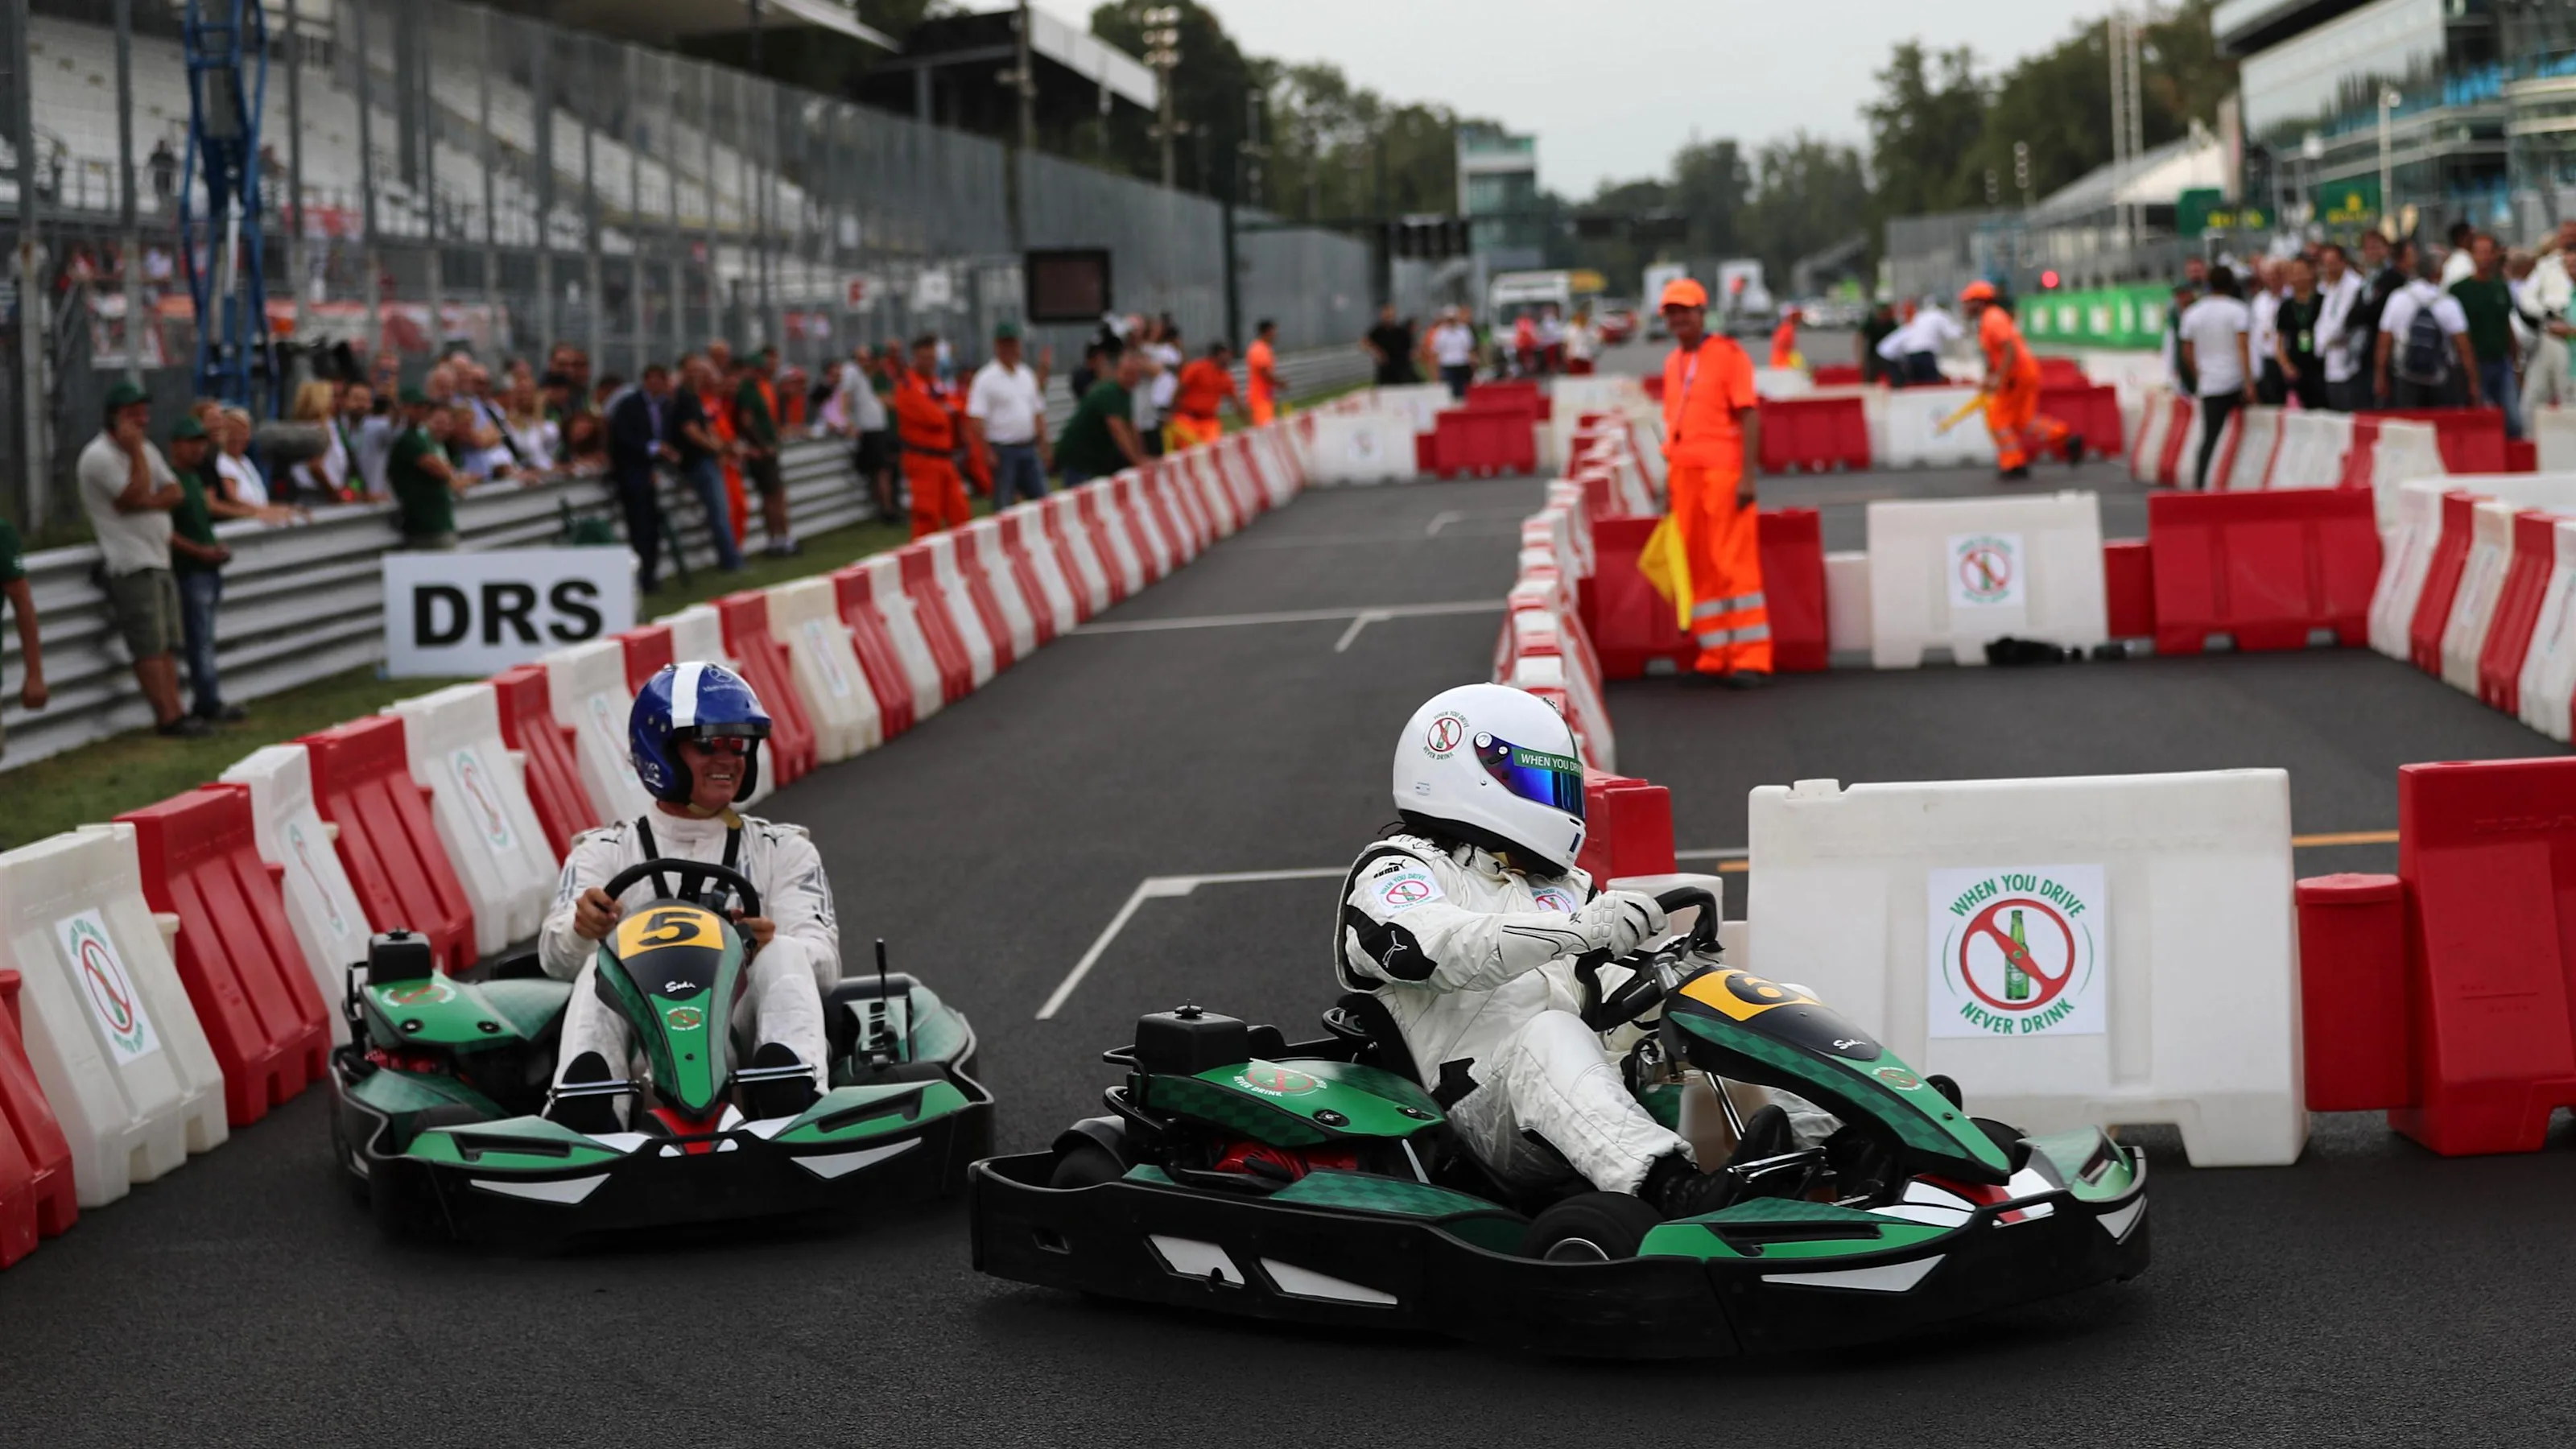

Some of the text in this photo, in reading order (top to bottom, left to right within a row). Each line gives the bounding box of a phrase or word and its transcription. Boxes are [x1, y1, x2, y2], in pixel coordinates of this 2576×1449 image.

[414, 579, 602, 648] DRS
[1521, 753, 1550, 767] WHEN
[1551, 758, 1569, 770] YOU
[1949, 873, 2086, 918] WHEN YOU DRIVE
[638, 912, 702, 947] 5
[1724, 972, 1801, 1005] 6
[1959, 997, 2074, 1034] NEVER DRINK
[1251, 1085, 1283, 1097] DRINK
